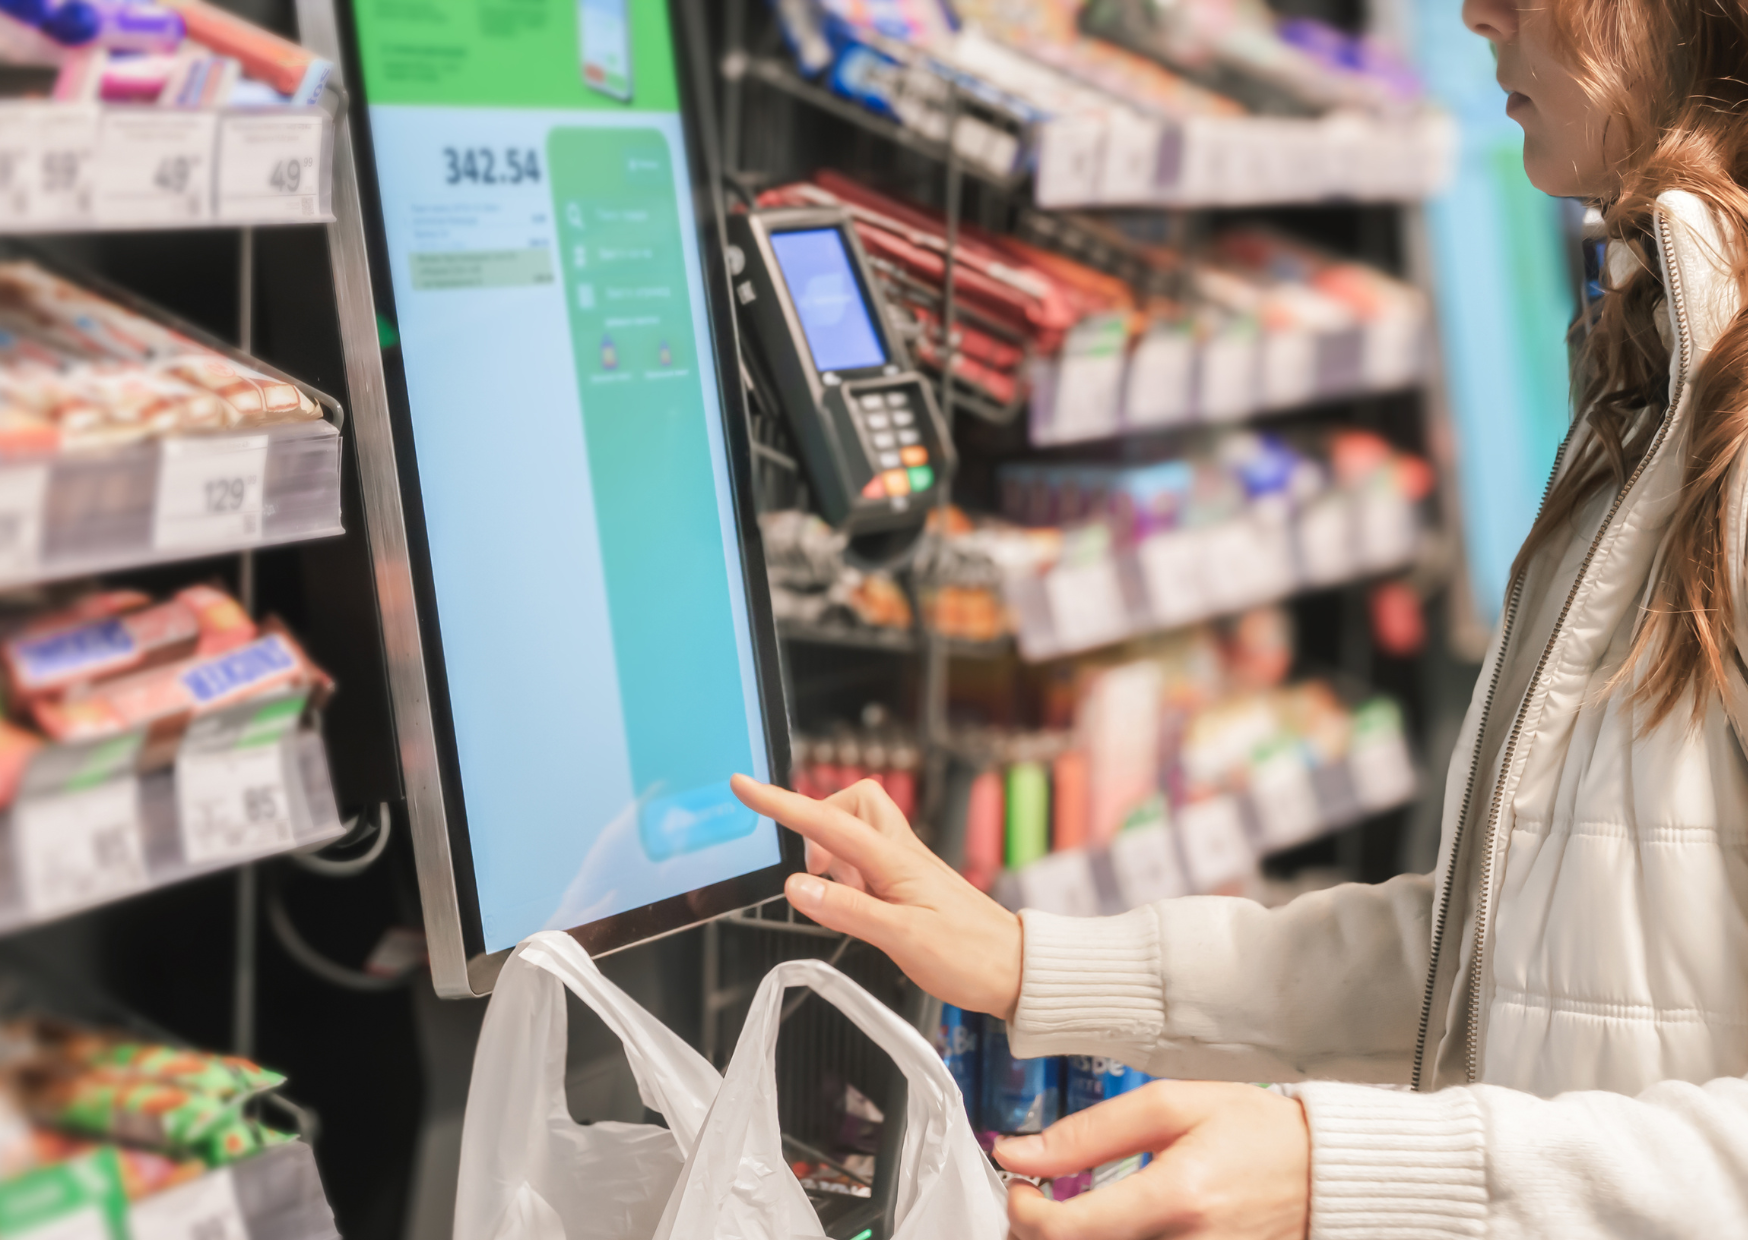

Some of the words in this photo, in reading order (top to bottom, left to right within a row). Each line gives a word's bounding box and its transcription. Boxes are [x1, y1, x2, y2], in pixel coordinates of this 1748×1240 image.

[270, 159, 301, 193] 49
[304, 157, 314, 168] 99
[443, 146, 541, 185] 342.54
[205, 478, 244, 512] 129
